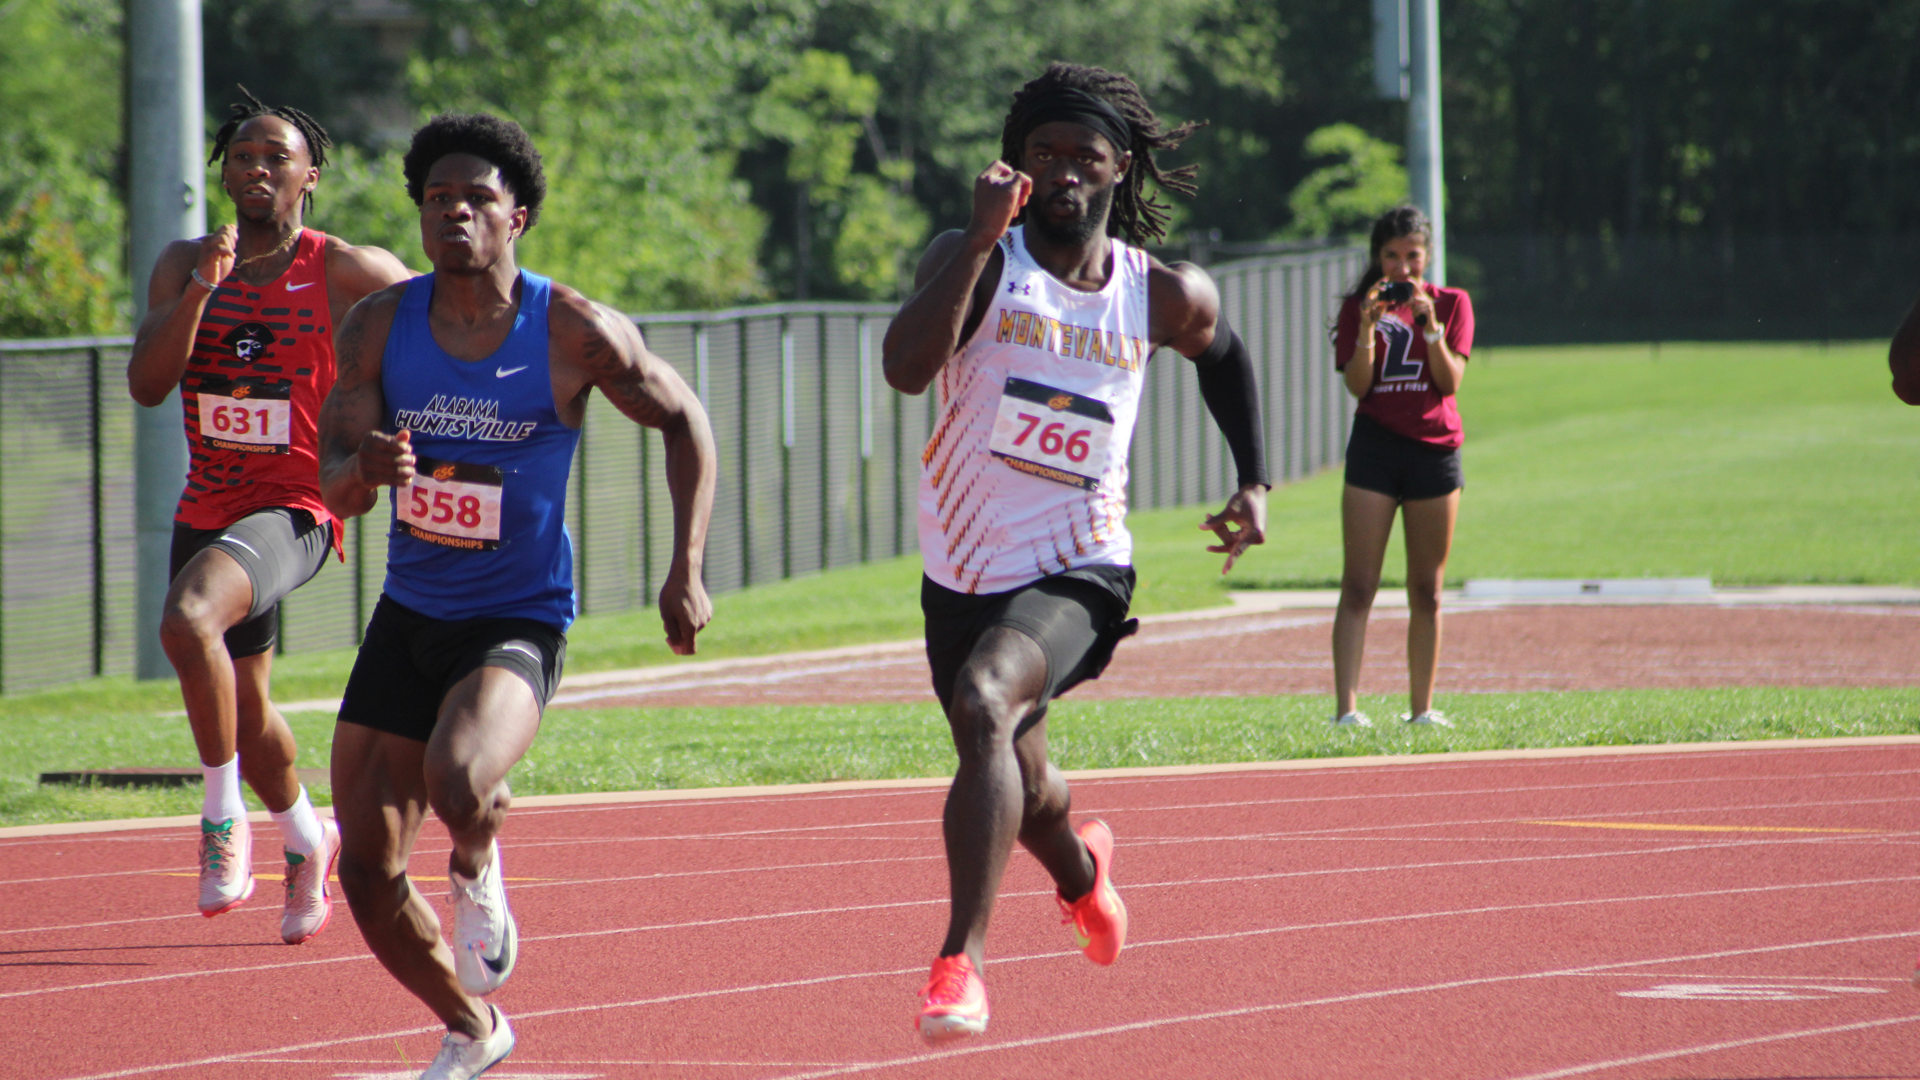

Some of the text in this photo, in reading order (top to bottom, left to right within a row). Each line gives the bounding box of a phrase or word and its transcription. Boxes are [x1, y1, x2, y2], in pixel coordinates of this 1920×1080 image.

[1404, 382, 1429, 392] FIELD
[212, 405, 269, 436] 631
[422, 393, 499, 421] ALABAMA
[395, 409, 537, 441] HUNTSVILLE
[1012, 411, 1091, 463] 766
[212, 439, 277, 453] CHAMPIONSHIPS
[432, 465, 455, 480] GSC
[1003, 457, 1085, 487] CHAMPIONSHIPS
[410, 485, 481, 529] 558
[410, 527, 484, 550] CHAMPIONSHIPS
